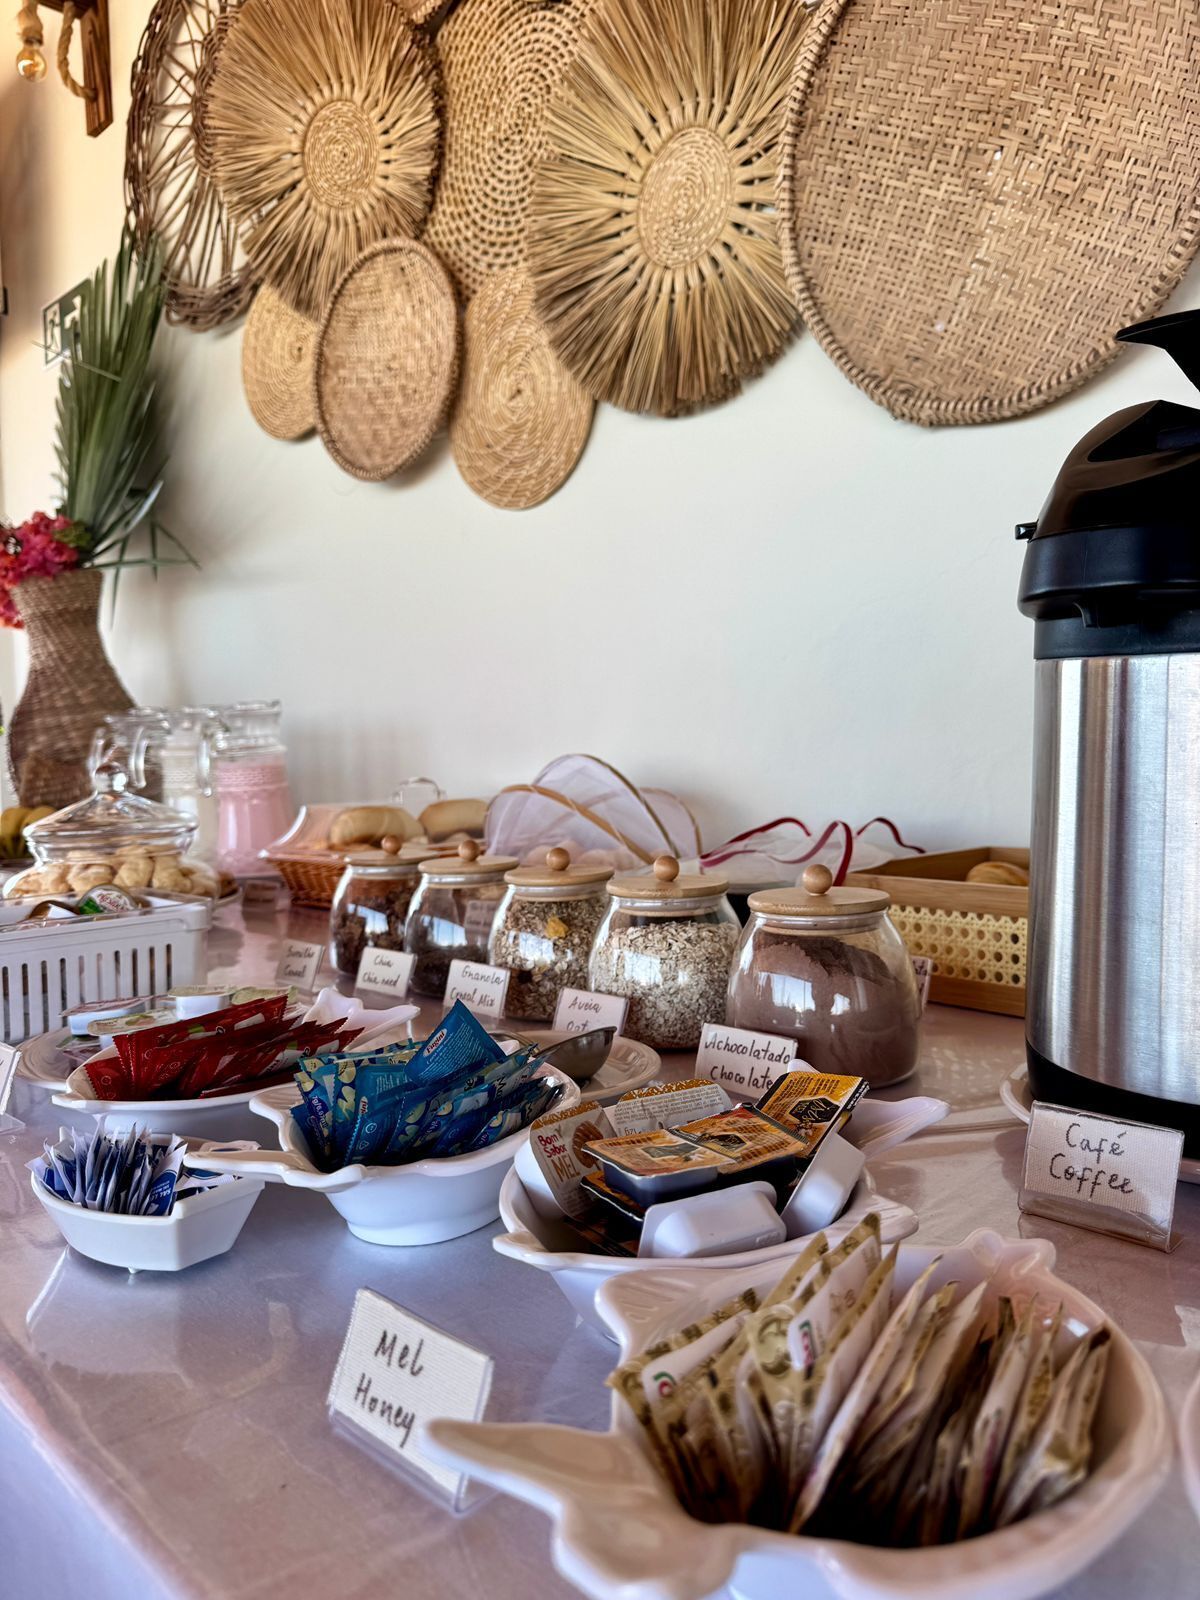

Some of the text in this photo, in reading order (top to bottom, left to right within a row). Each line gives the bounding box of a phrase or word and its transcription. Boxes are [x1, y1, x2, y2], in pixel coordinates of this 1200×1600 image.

[461, 964, 504, 985] Granola
[568, 996, 602, 1013] Aveia
[704, 1032, 791, 1065] Achocolatado
[710, 1065, 774, 1090] Chocolate
[1065, 1122, 1127, 1164] Café
[550, 1152, 580, 1182] MEL
[1049, 1152, 1134, 1198] Coffee
[373, 1329, 425, 1377] Mel
[353, 1372, 416, 1449] Honey
